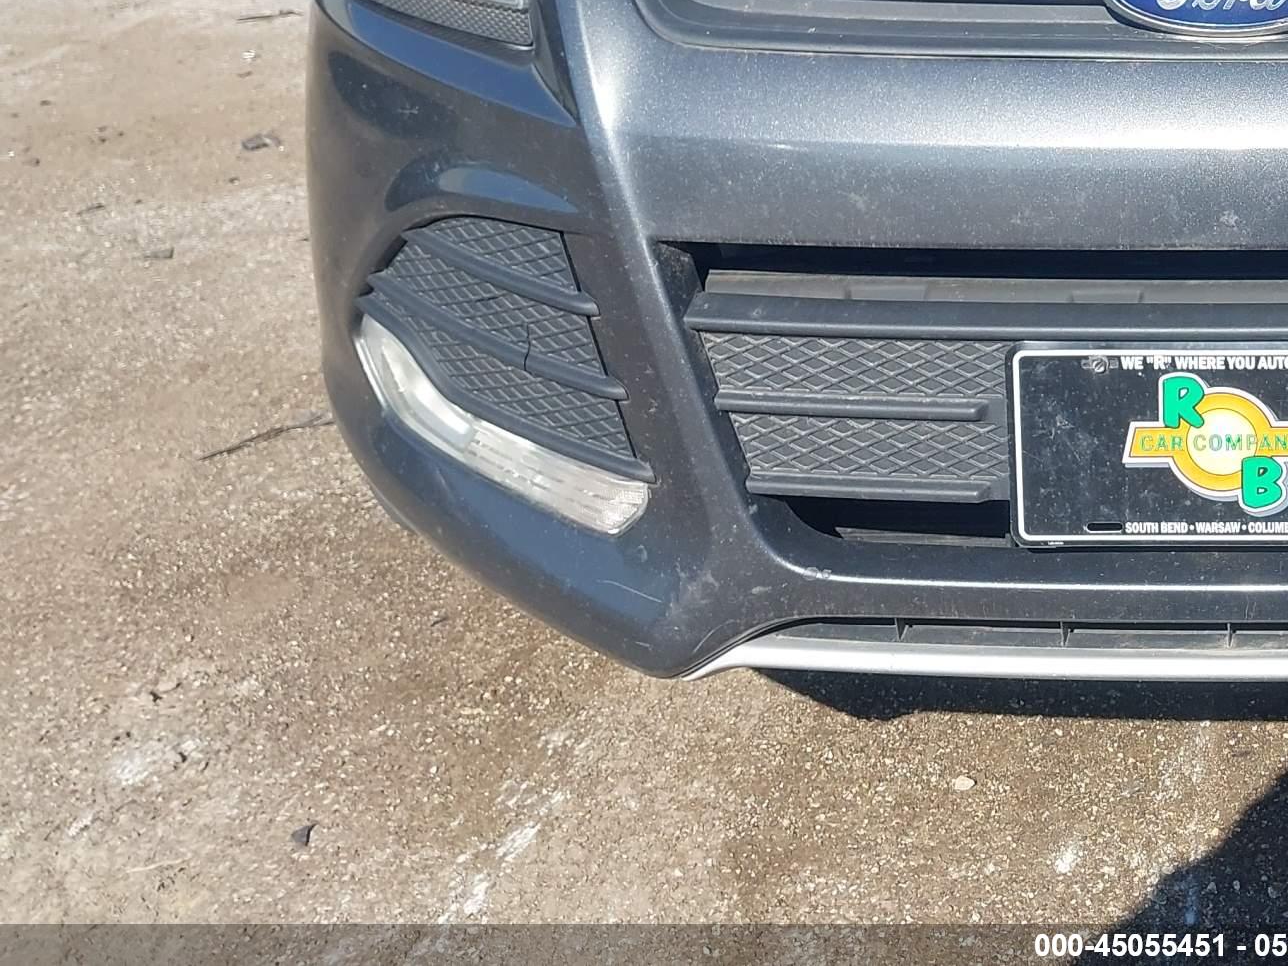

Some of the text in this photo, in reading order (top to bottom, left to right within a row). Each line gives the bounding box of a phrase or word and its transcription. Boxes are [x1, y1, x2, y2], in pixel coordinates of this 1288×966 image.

[1121, 356, 1144, 370] WE
[1147, 355, 1172, 370] "R"
[1174, 356, 1225, 370] WHERE
[1226, 356, 1256, 370] YOU
[1163, 376, 1204, 429] R
[1140, 434, 1184, 451] CAR
[1242, 456, 1282, 509] B
[1125, 521, 1159, 534] SOUTH
[1160, 521, 1188, 534] BEND
[1195, 521, 1241, 534] WARSAW
